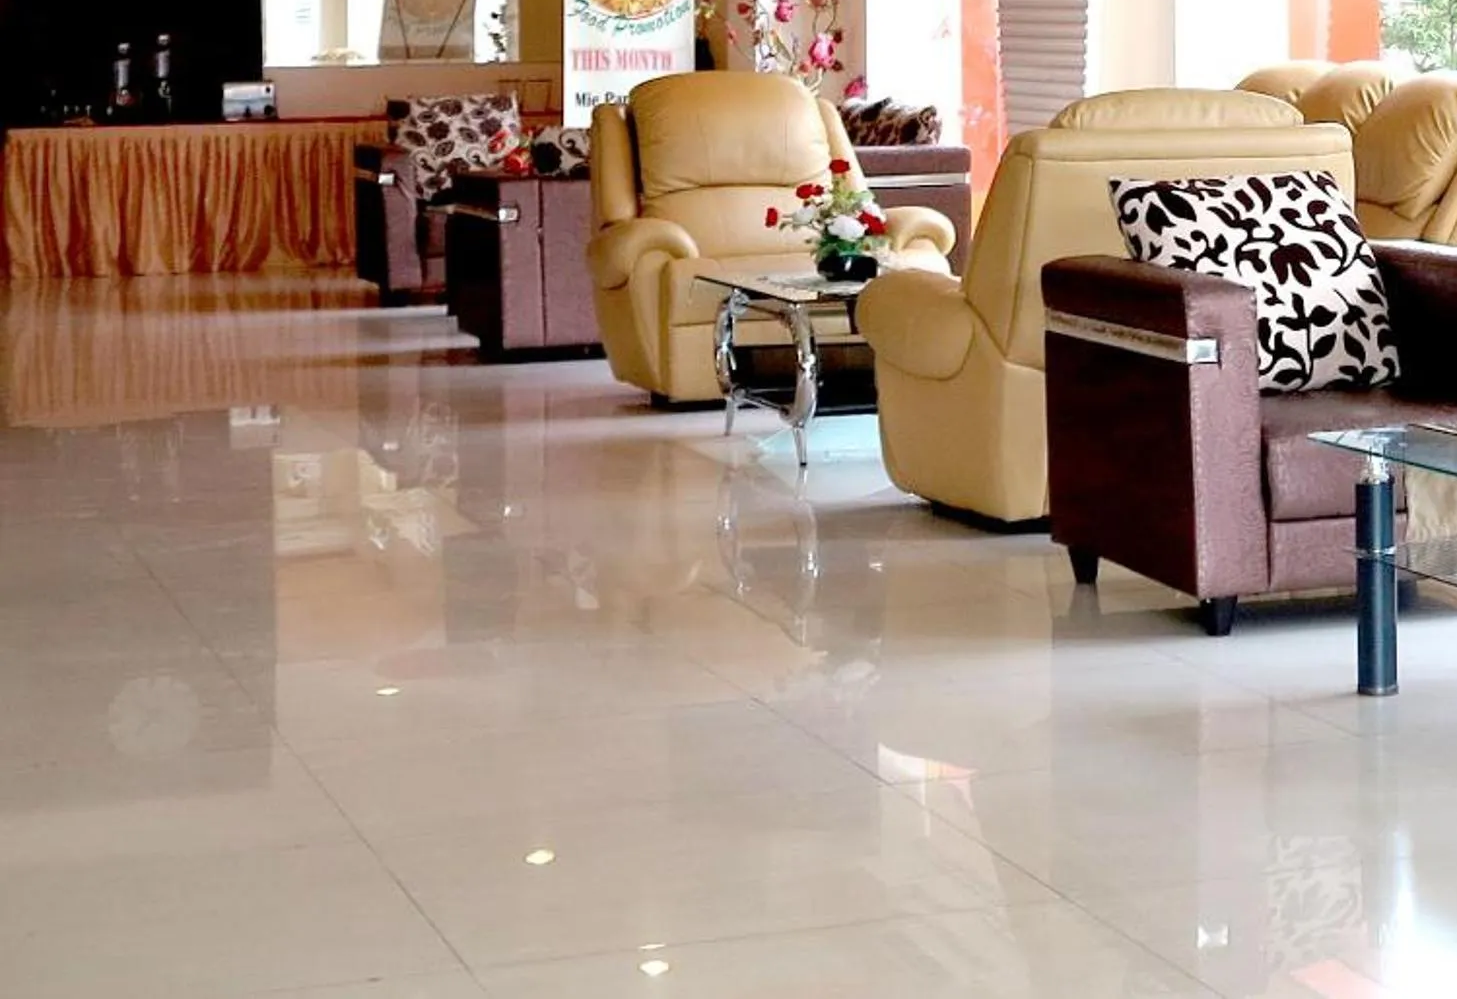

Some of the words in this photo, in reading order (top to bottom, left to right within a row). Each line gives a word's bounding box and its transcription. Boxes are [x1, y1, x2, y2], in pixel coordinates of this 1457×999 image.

[611, 0, 690, 35] Promotion
[572, 49, 611, 71] THIS
[615, 49, 673, 71] MONTH
[575, 91, 599, 107] Mie
